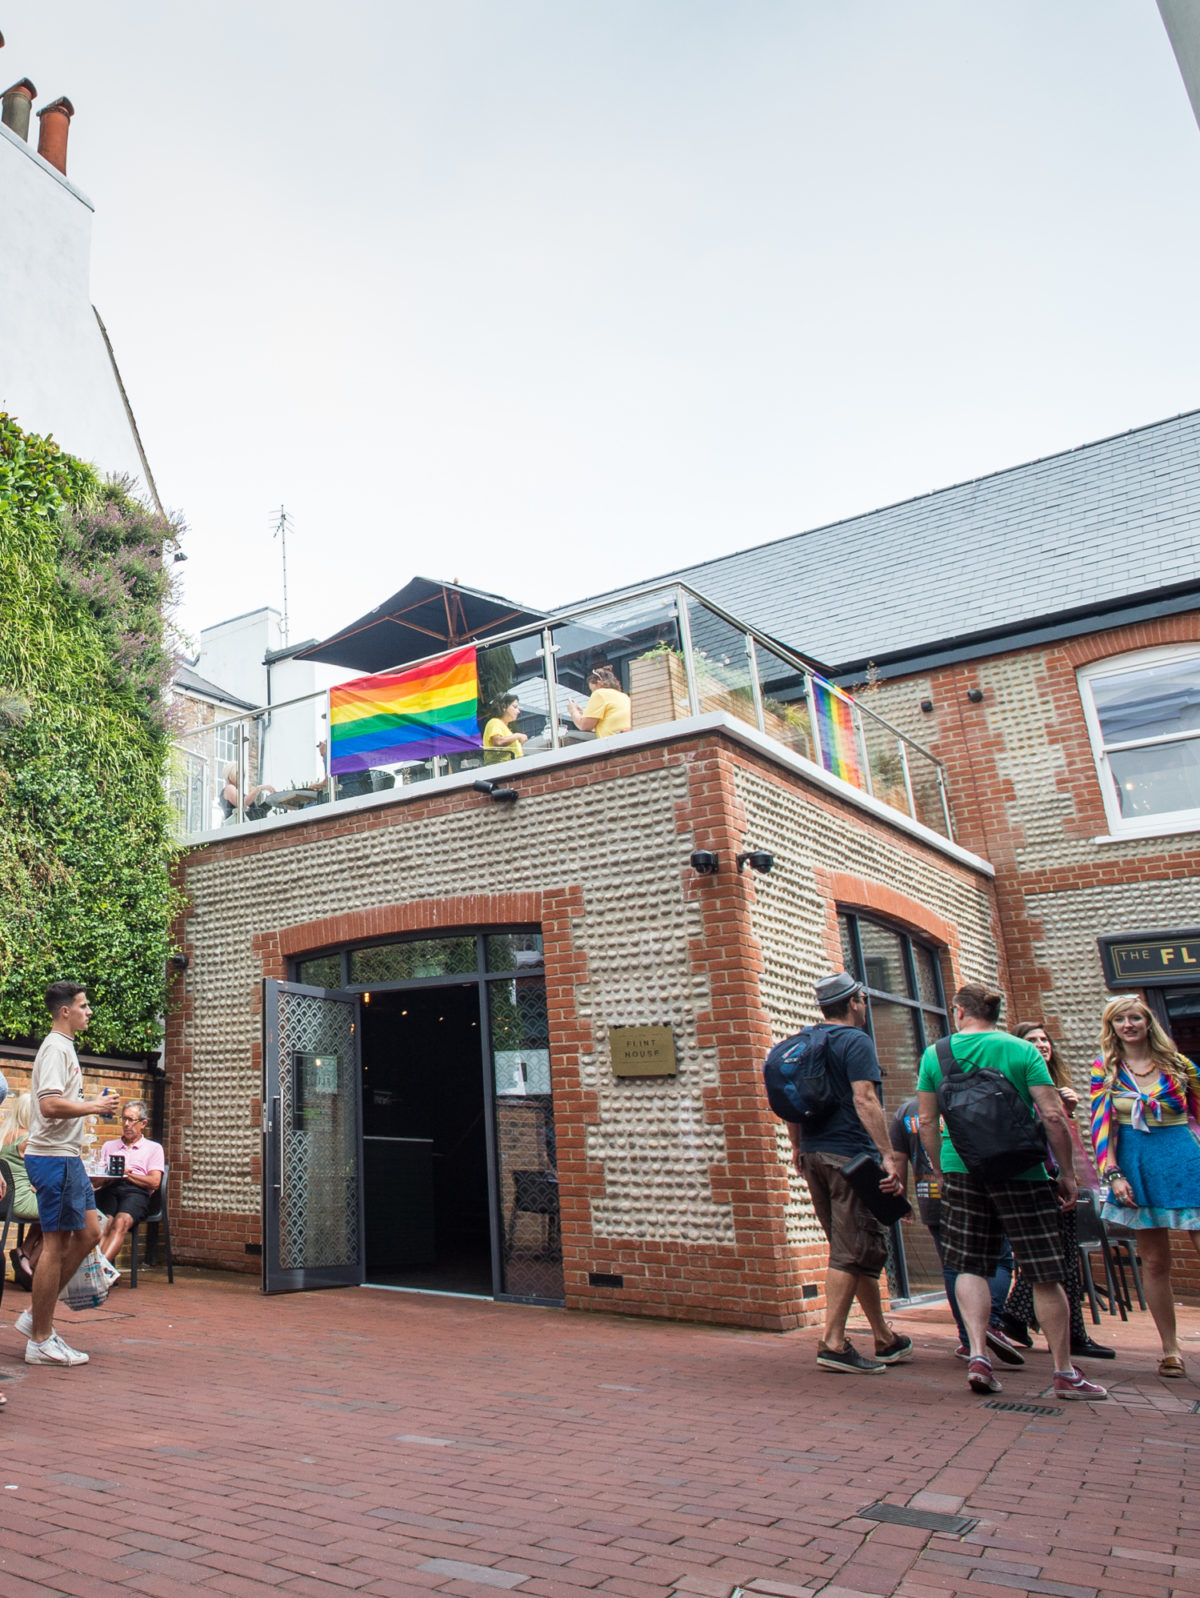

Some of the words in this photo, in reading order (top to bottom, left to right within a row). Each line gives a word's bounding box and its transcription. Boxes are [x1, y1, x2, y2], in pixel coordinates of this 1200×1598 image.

[1119, 949, 1151, 961] THE
[1160, 947, 1197, 965] FL
[626, 1039, 657, 1048] FLINT
[624, 1050, 661, 1058] HOUSE
